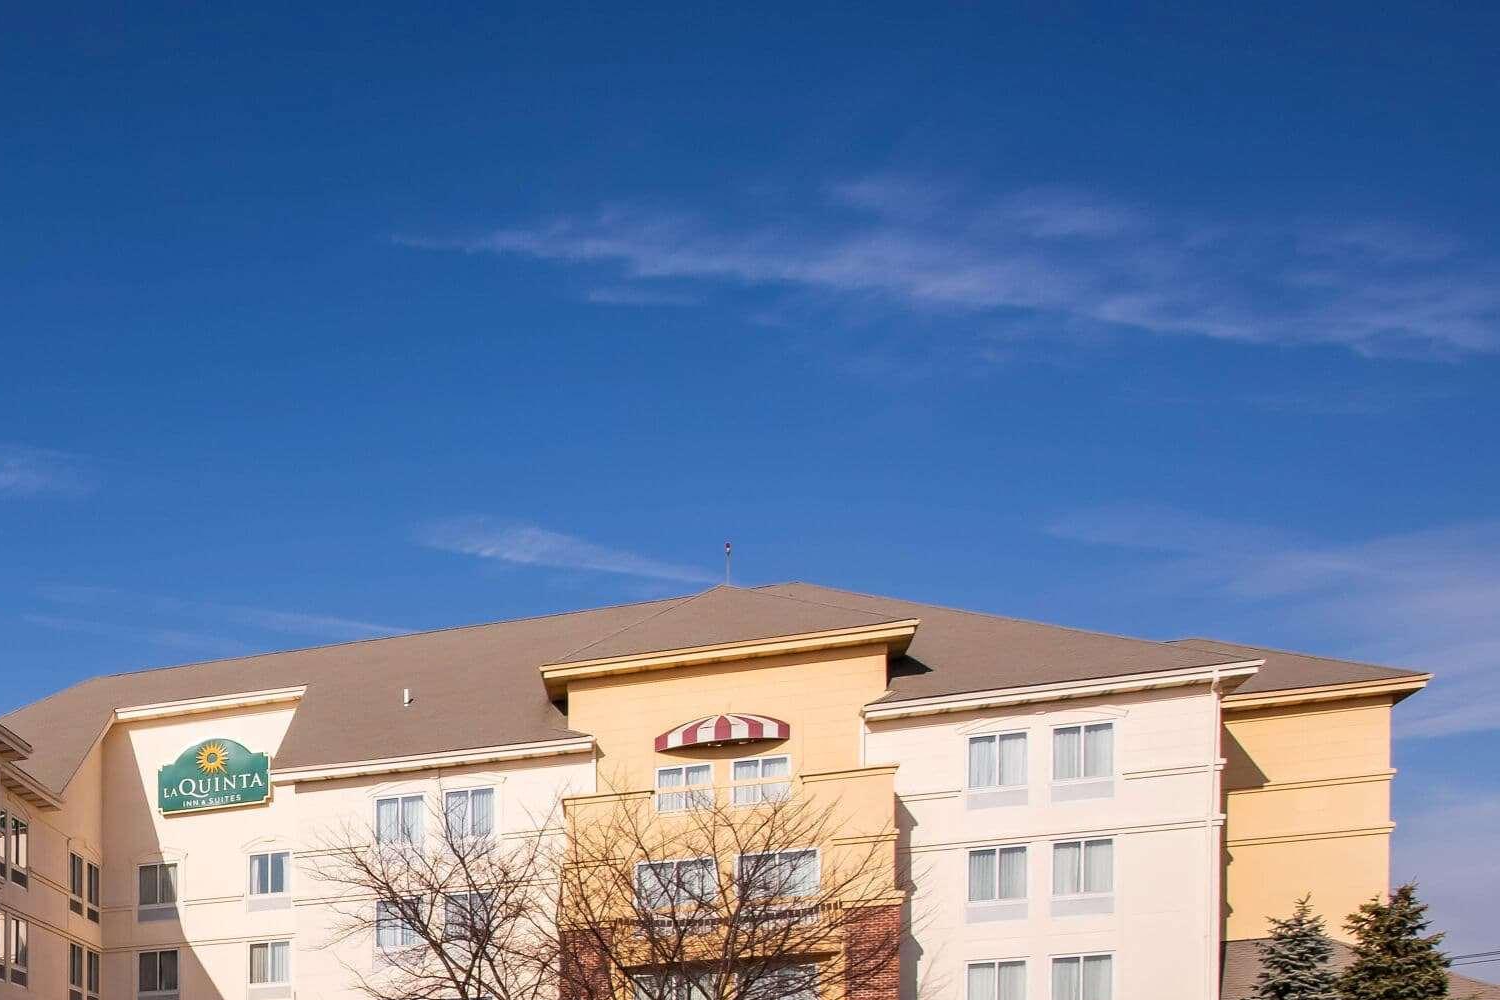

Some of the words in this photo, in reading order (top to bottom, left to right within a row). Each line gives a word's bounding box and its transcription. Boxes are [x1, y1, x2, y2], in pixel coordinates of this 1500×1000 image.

[164, 787, 178, 799] LA
[179, 772, 263, 798] QUINTA
[182, 799, 199, 808] INN
[208, 794, 241, 805] SUITES
